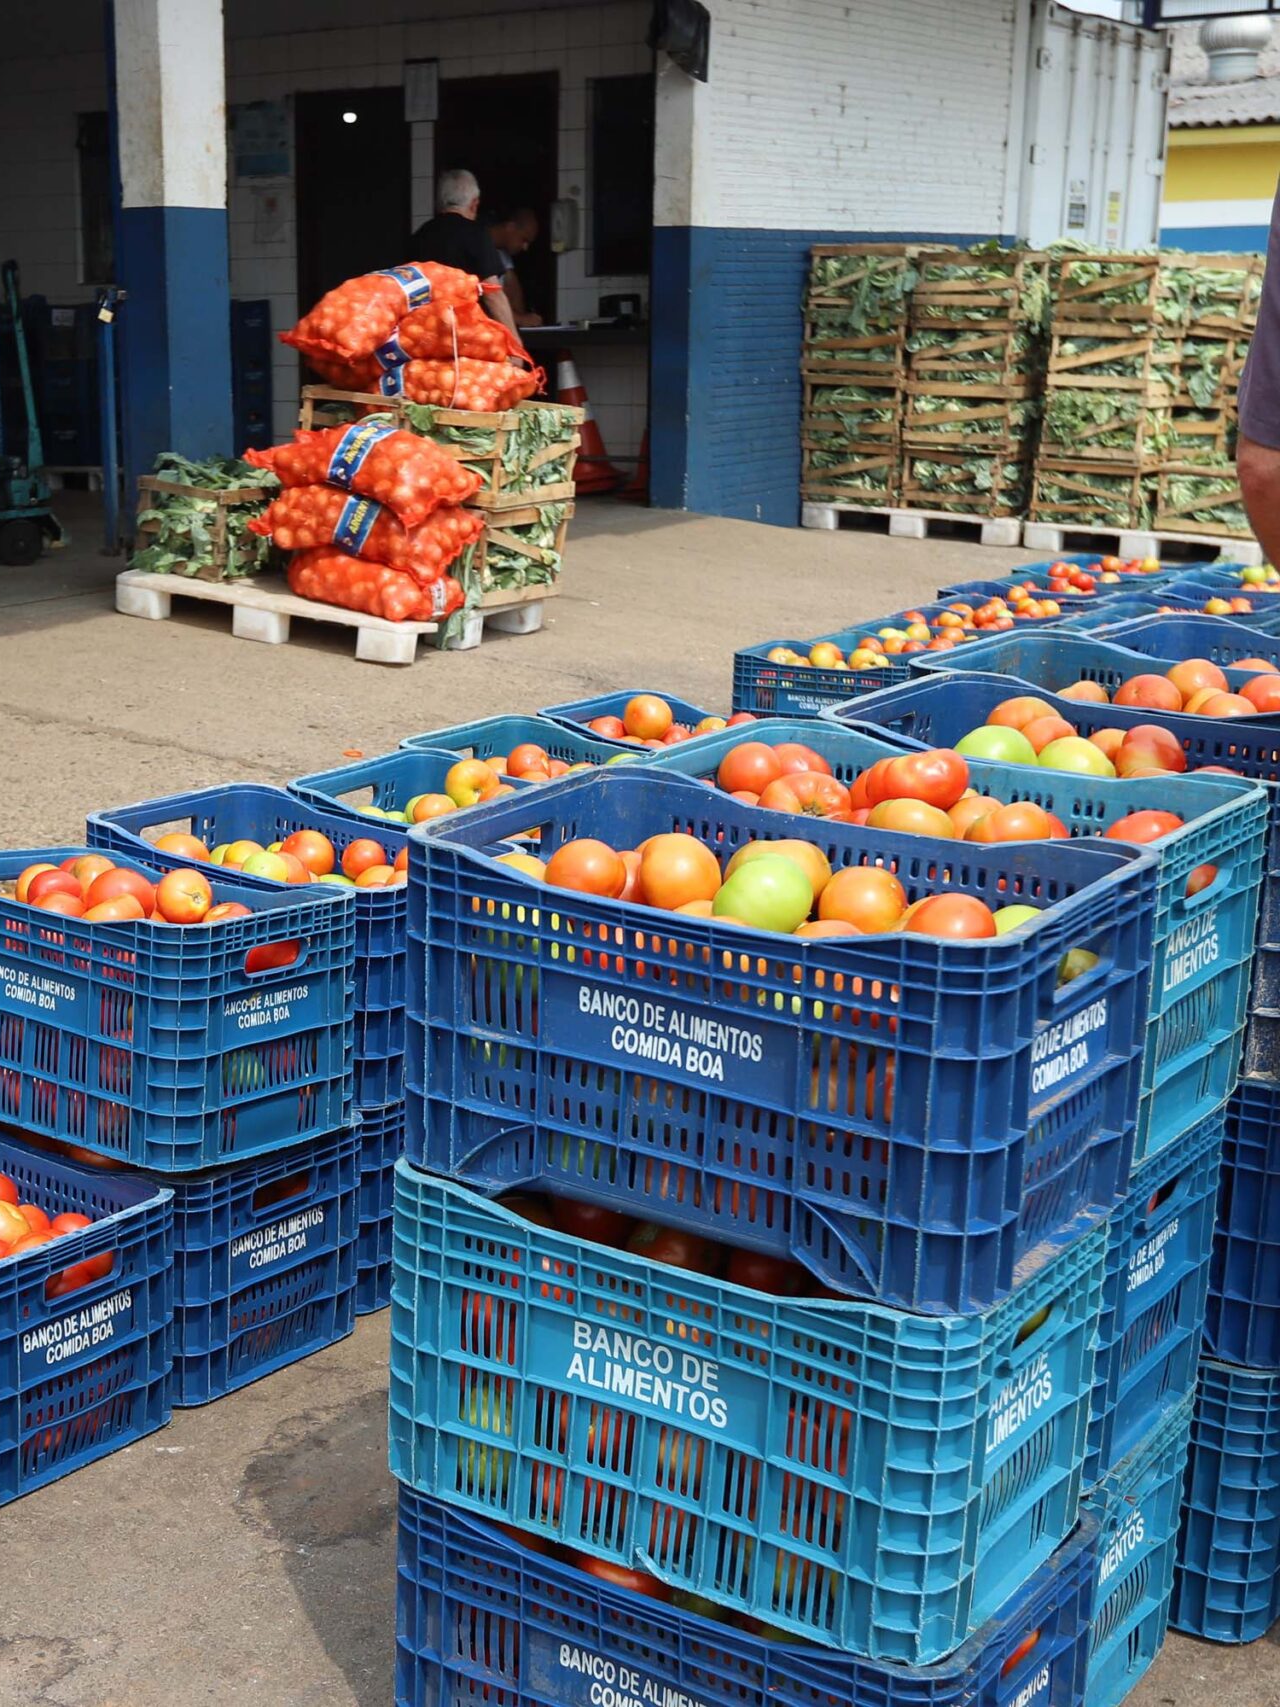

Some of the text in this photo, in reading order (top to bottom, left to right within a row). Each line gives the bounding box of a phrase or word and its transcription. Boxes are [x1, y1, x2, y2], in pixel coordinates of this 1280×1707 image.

[1165, 905, 1219, 960] ANCO DE
[19, 971, 29, 987] DE
[31, 975, 76, 1001] ALIMENTOS
[1163, 933, 1219, 993] LIMENTOS
[5, 983, 56, 1011] COMIDA BOA
[225, 985, 309, 1017] ANCO DE ALIMENTOS
[238, 1006, 290, 1029] COMIDA BOA
[1062, 998, 1107, 1047] ALIMENTOS
[579, 986, 763, 1062] BANCO DE ALIMENTOS
[611, 1026, 724, 1082] COMIDA BOA
[1032, 1052, 1071, 1094] COMIDA
[1070, 1041, 1089, 1074] BOA
[232, 1206, 324, 1257] BANCO DE ALIMENTOS
[249, 1232, 307, 1269] COMIDA BOA
[1148, 1218, 1179, 1258] ALIMENTOS
[1154, 1249, 1165, 1274] BOA
[23, 1290, 132, 1353] BANCO DE ALIMENTOS
[46, 1321, 114, 1364] COMIDA BOA
[573, 1321, 720, 1392] BANCO DE
[567, 1352, 728, 1429] ALIMENTOS
[985, 1372, 1052, 1455] LIMENTOS
[989, 1370, 1028, 1419] ANCO
[1098, 1518, 1144, 1586] MENTOS
[559, 1644, 616, 1684] BANCO
[620, 1667, 640, 1696] DE
[590, 1683, 644, 1707] COMI
